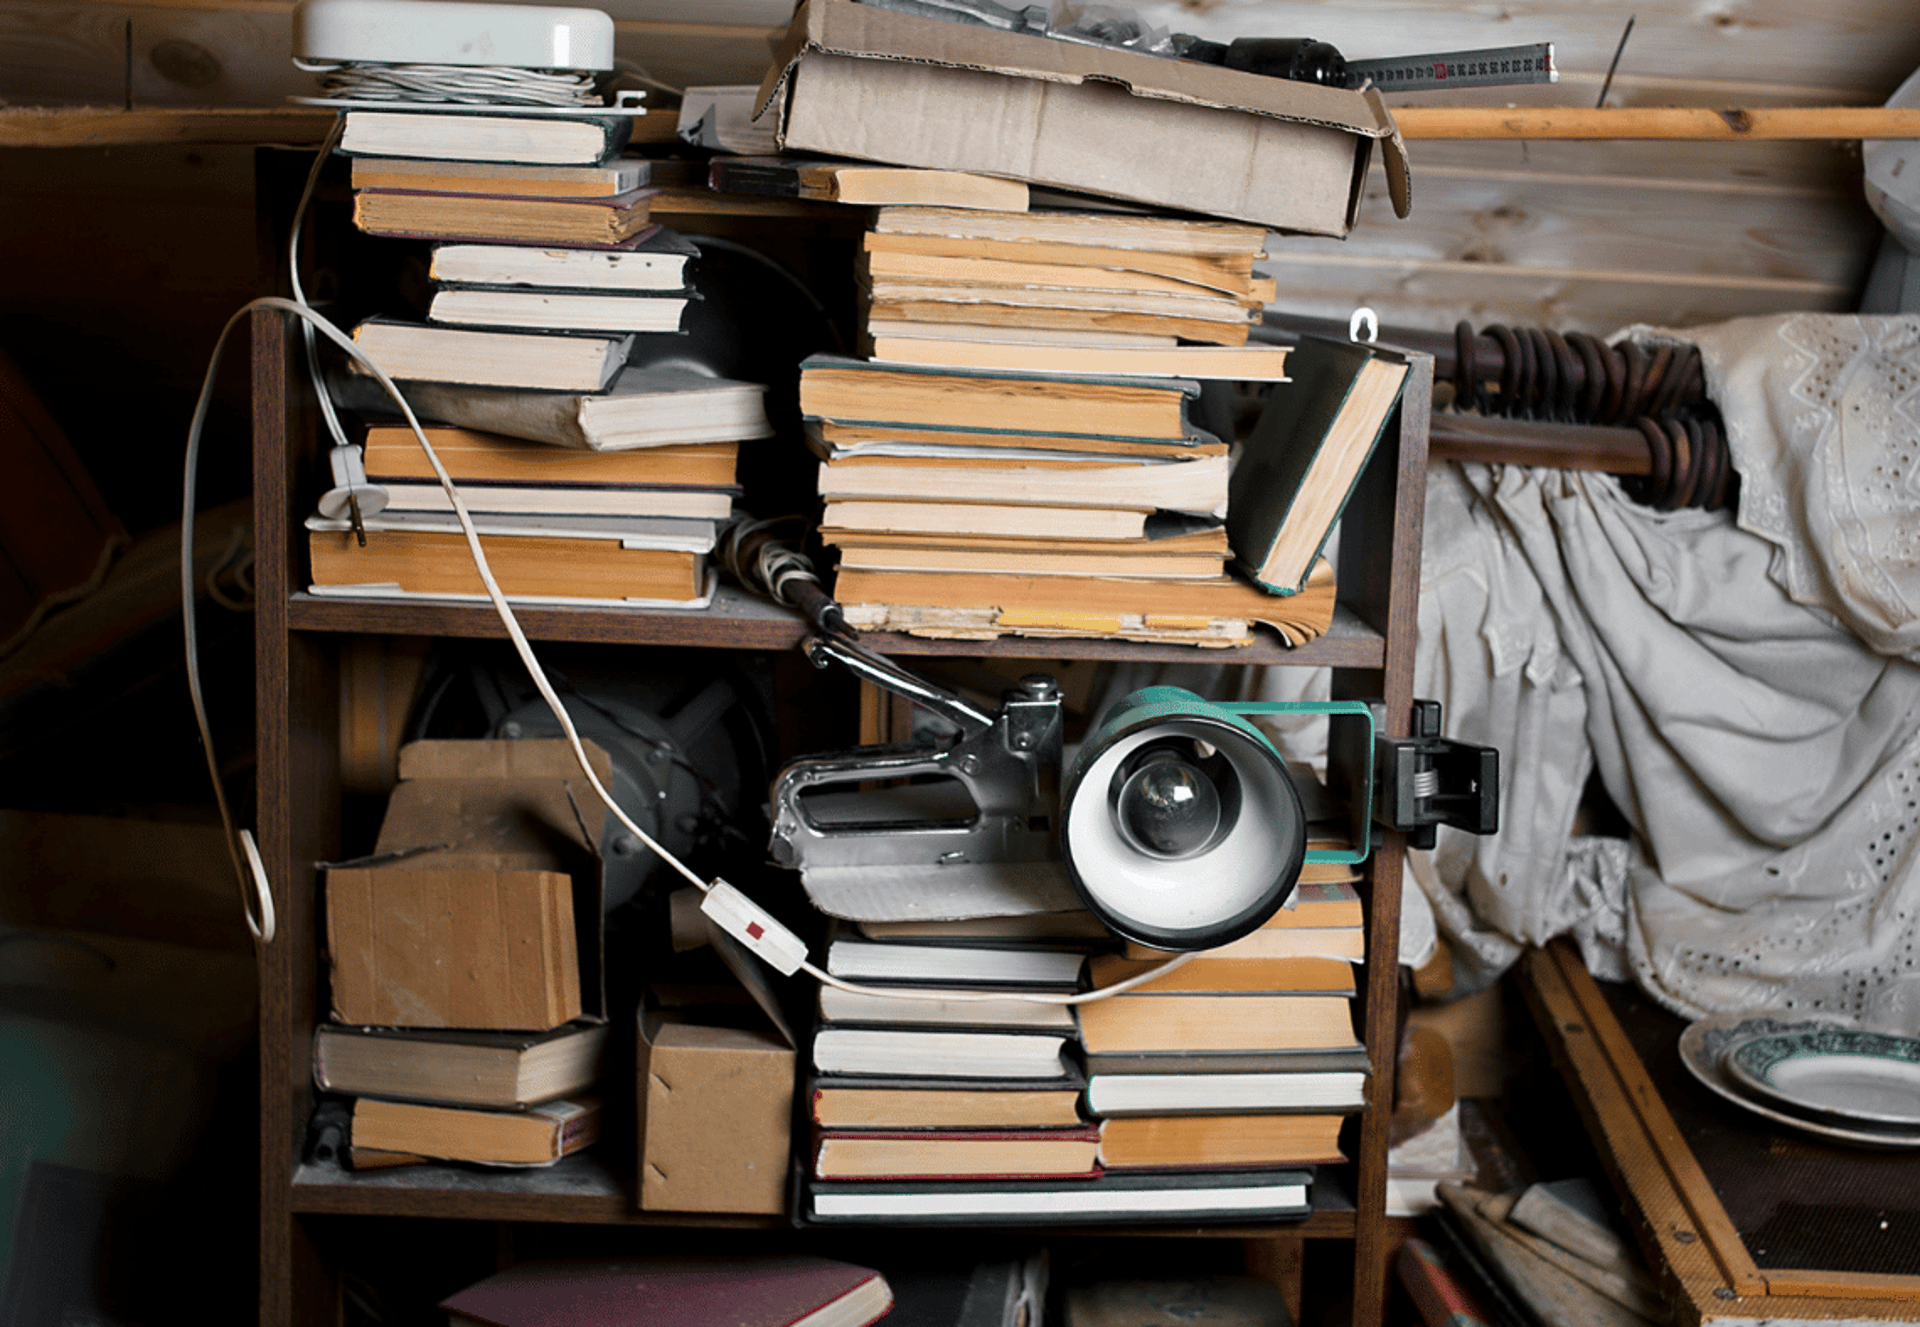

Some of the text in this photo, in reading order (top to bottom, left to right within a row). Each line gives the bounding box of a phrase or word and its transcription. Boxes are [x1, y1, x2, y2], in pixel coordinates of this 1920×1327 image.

[1501, 60, 1510, 73] 34
[1512, 59, 1521, 73] 33
[1523, 58, 1533, 72] 32
